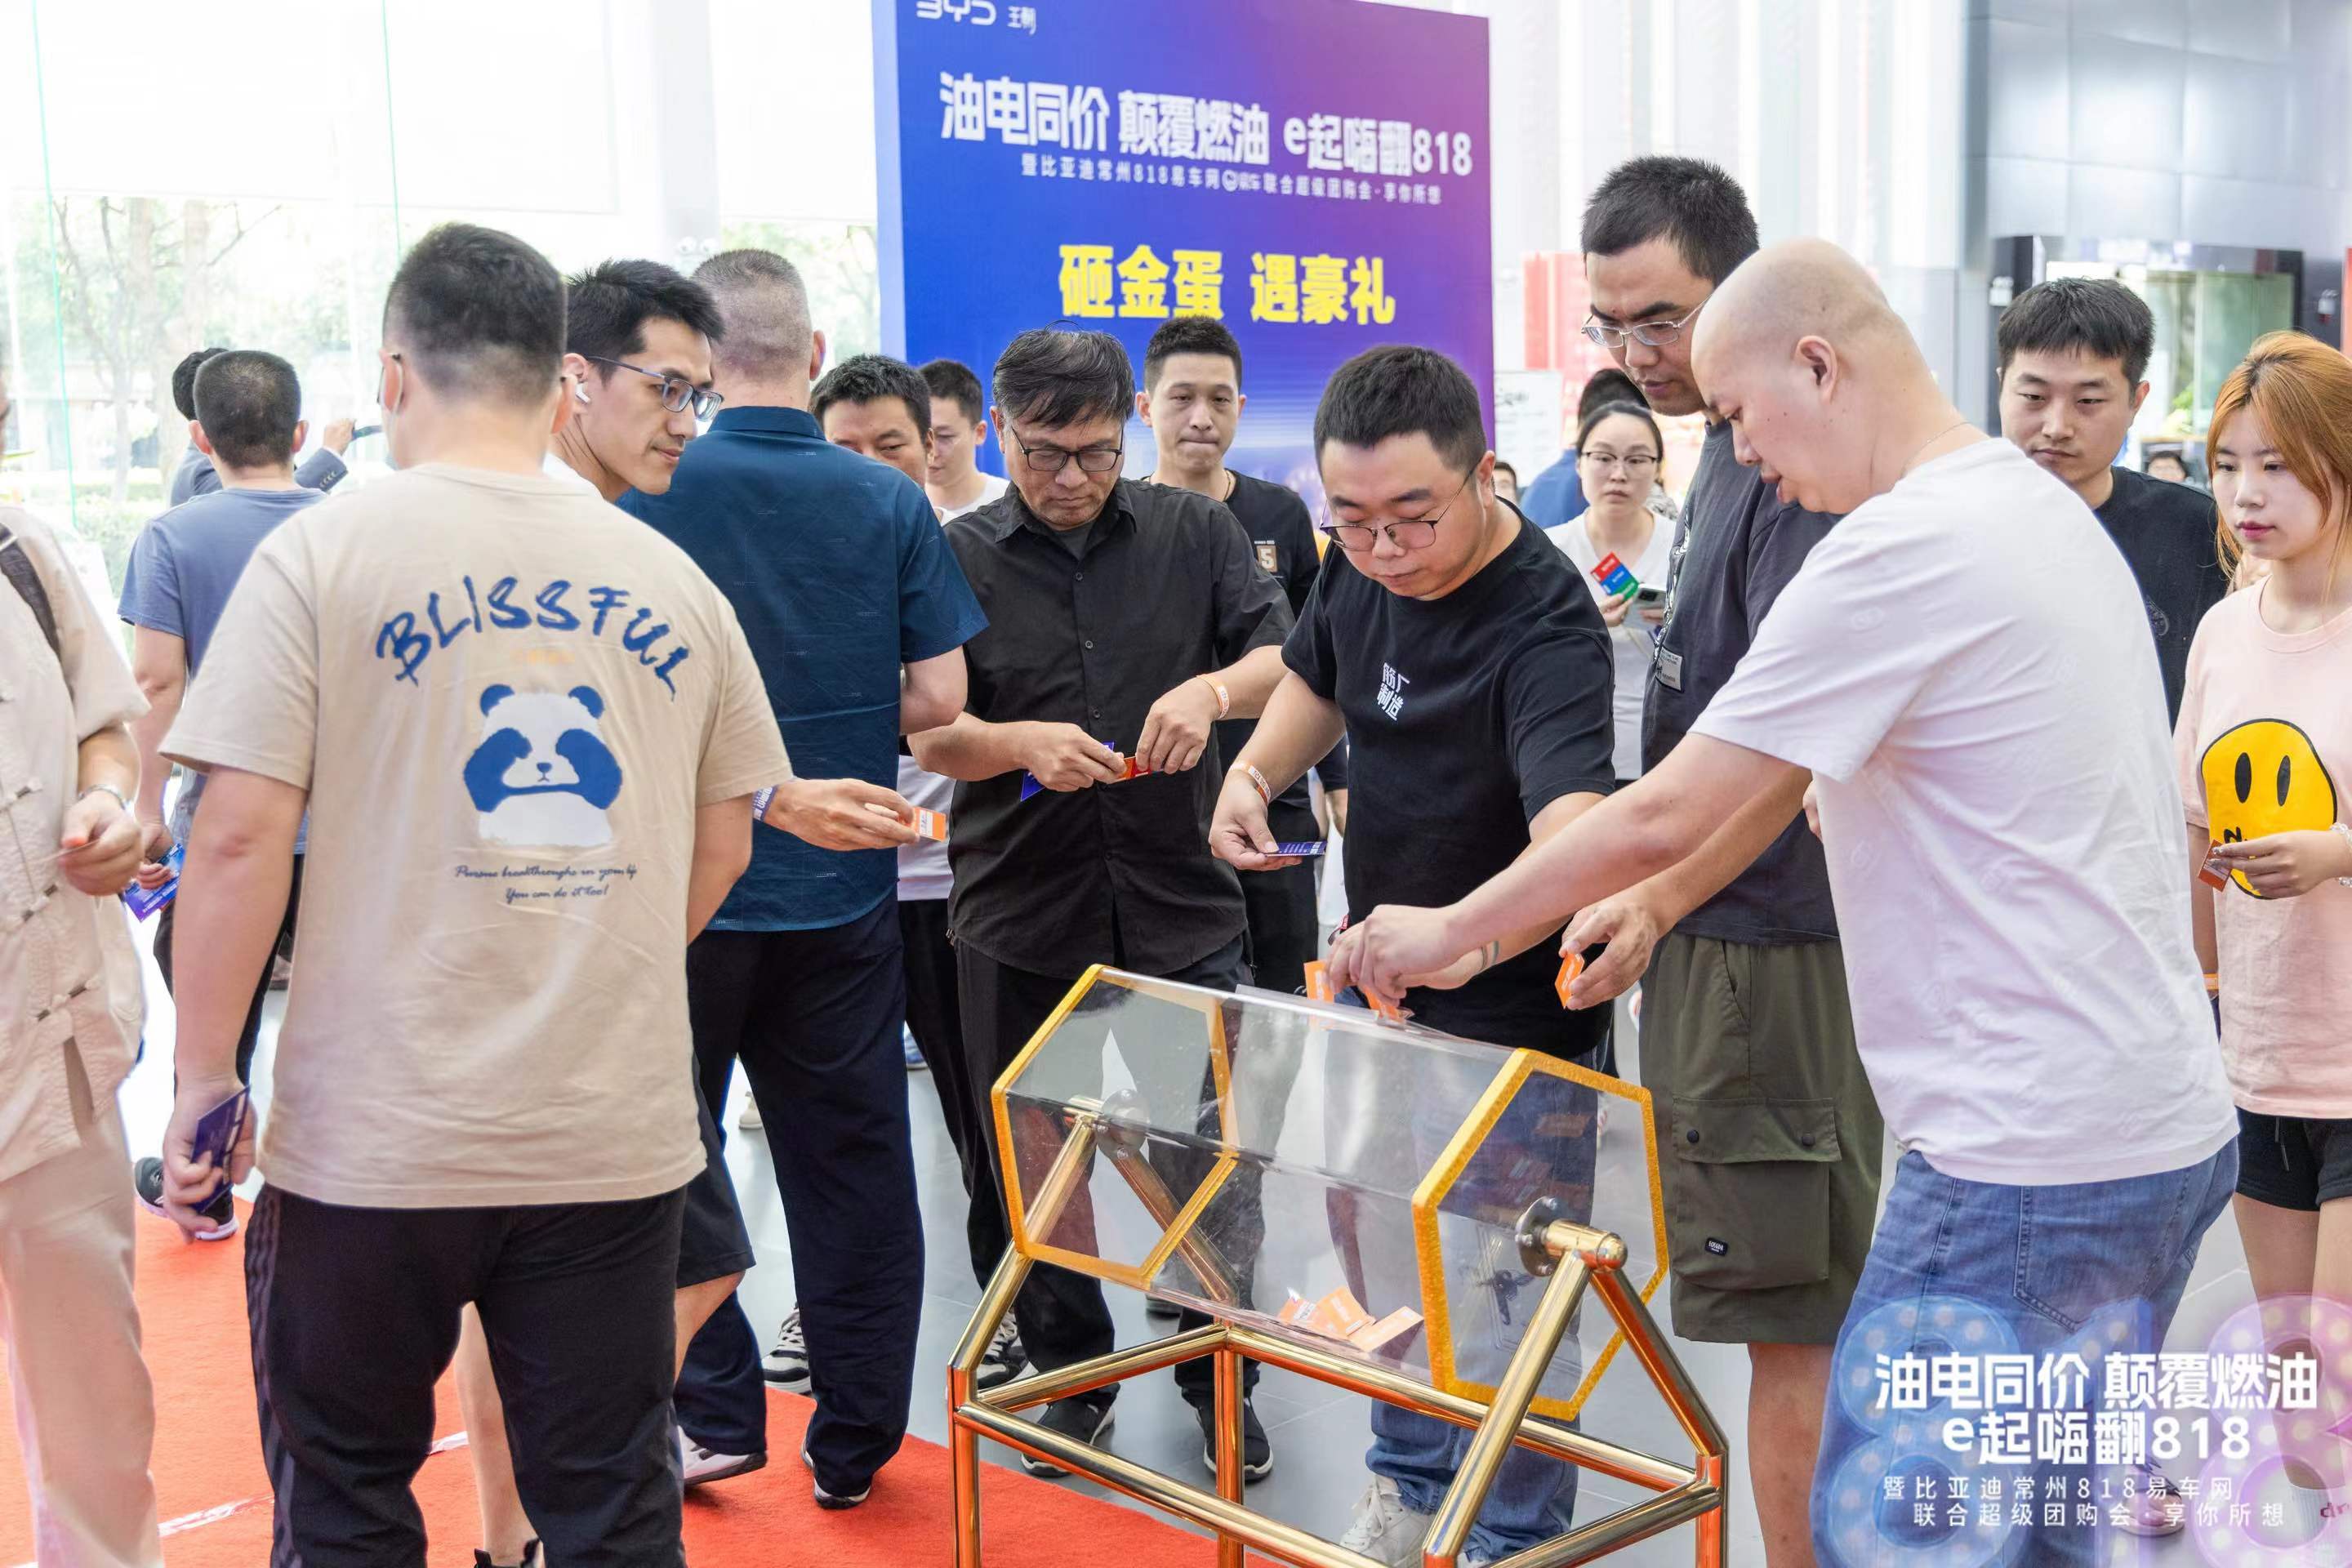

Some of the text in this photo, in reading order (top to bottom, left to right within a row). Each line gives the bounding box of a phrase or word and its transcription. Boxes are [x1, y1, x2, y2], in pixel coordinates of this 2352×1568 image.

[940, 72, 1472, 176] 油电同价 颠覆燃油 e起嗨翻818
[1060, 245, 1395, 324] 砸金蛋 遇豪礼
[376, 576, 689, 702] BLISSFUL
[1377, 683, 1404, 721] 制造
[506, 887, 529, 904] You
